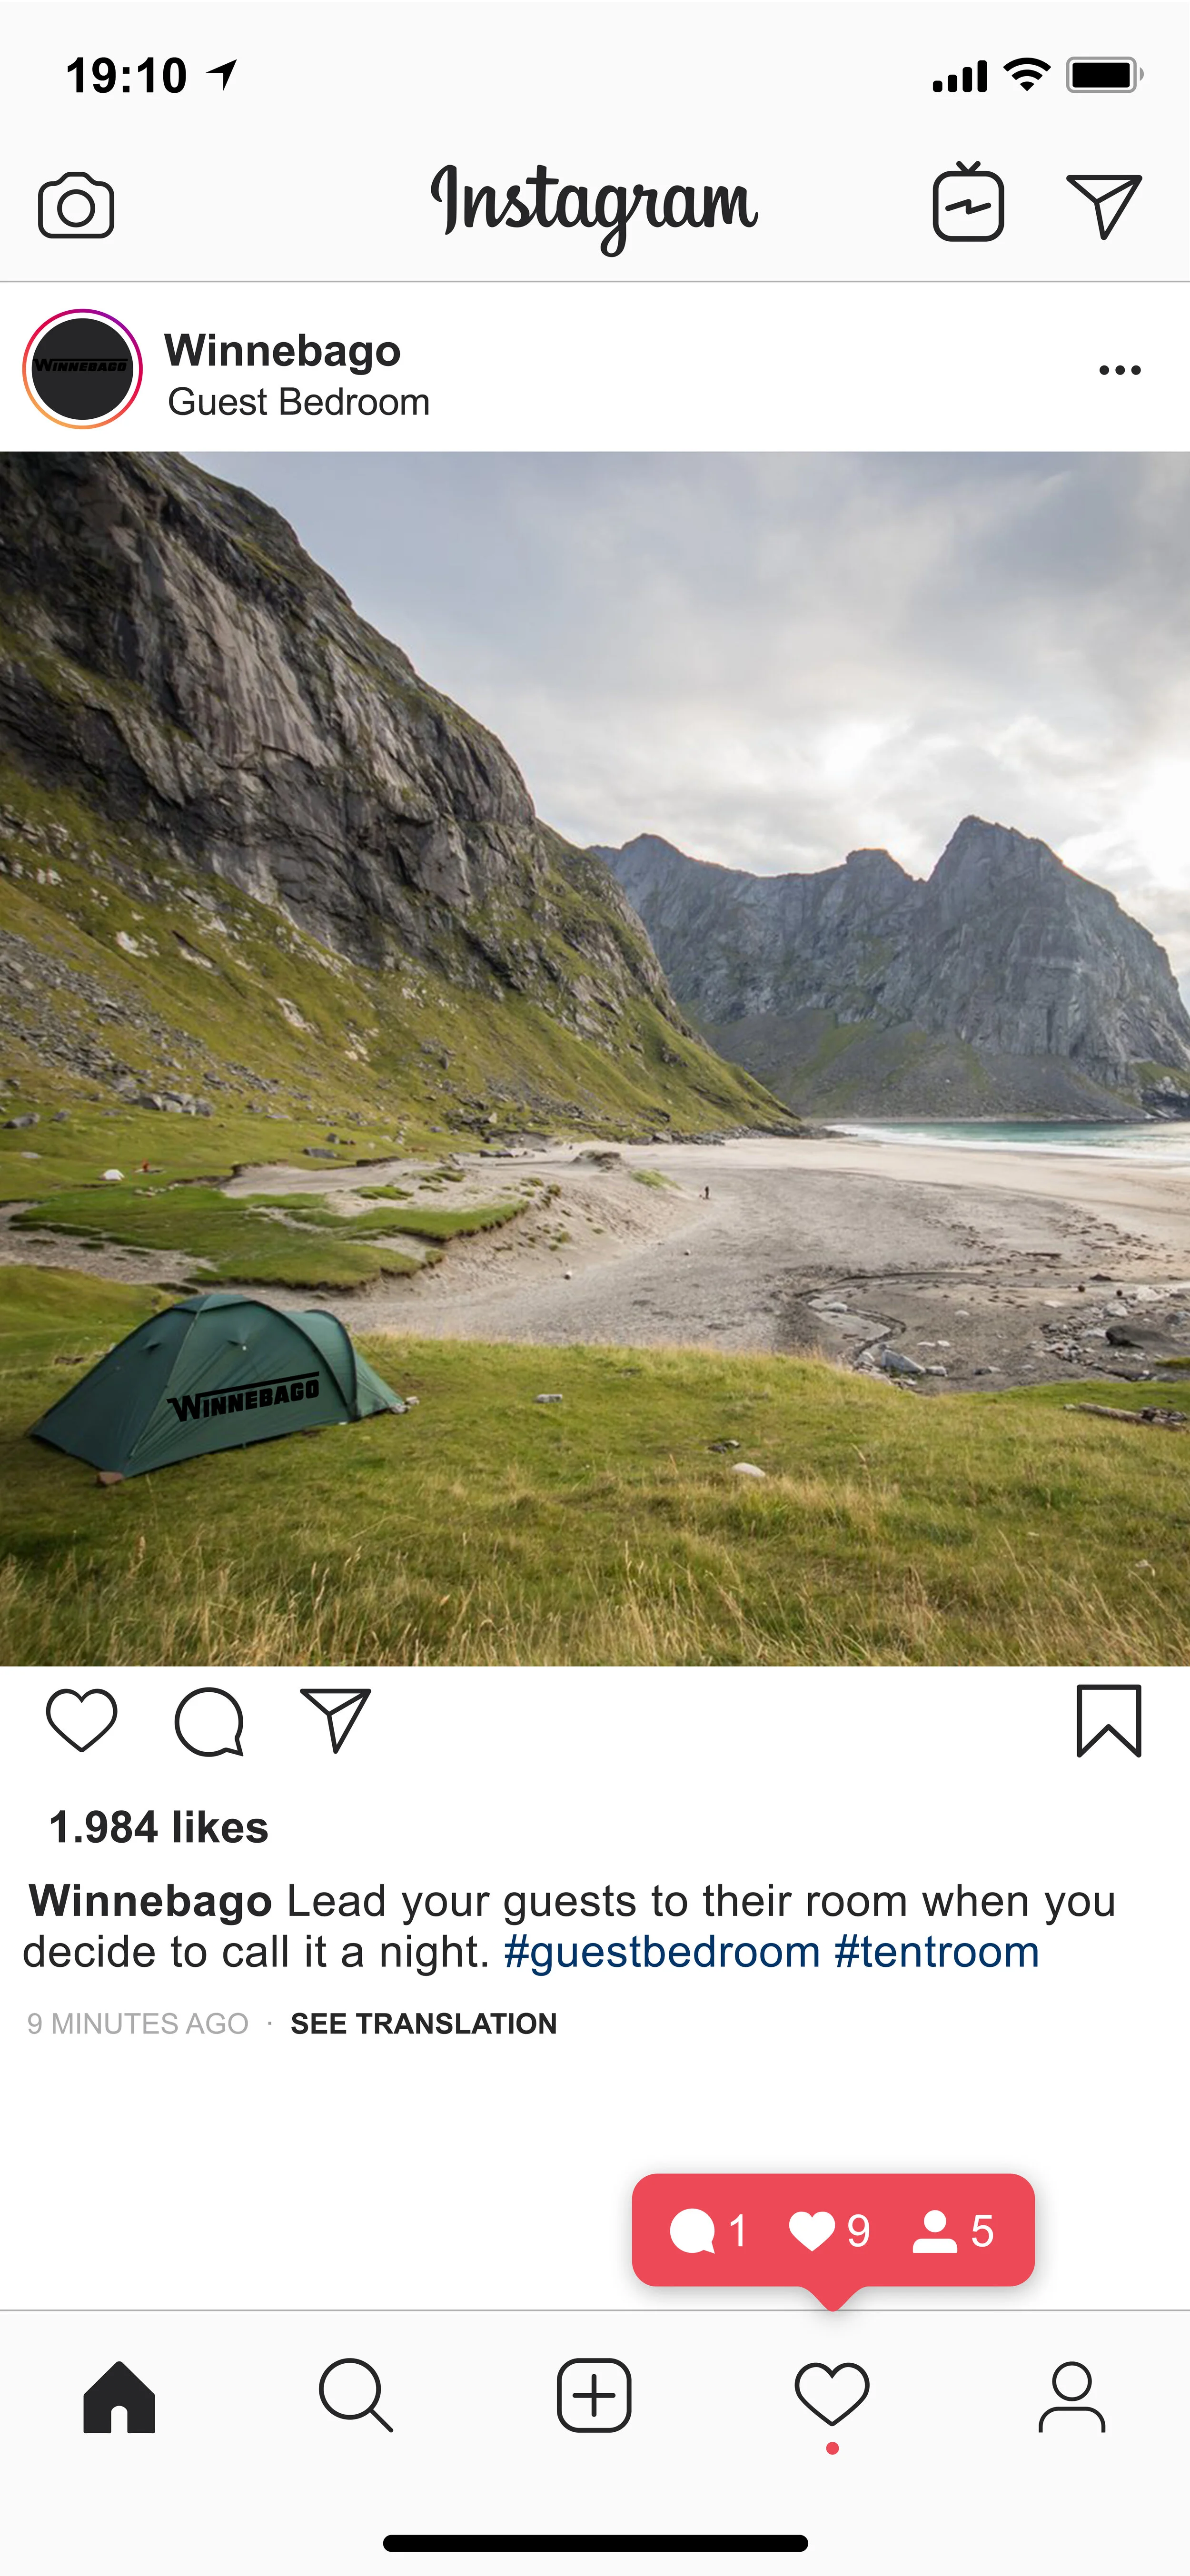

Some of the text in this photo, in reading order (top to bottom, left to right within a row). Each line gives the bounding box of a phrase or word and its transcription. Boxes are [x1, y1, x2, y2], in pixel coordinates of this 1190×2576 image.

[68, 57, 186, 93] 19:10
[431, 165, 758, 257] Instagram
[33, 359, 128, 371] WINNEBAGO
[164, 334, 400, 375] Winnebago
[169, 387, 428, 415] Guest Bedroom
[167, 1371, 319, 1422] WINNEBAGO
[51, 1810, 268, 1843] 1.984 likes
[29, 1884, 1114, 1925] Winnebago Lead your guests to their room when you
[23, 1934, 1038, 1976] decide to call it a night. #guestbedroom #tentroom
[28, 2013, 248, 2034] 9 MINUTES AGO
[291, 2013, 556, 2034] SEE TRANSLATION
[731, 2214, 993, 2247] 1 9 5
